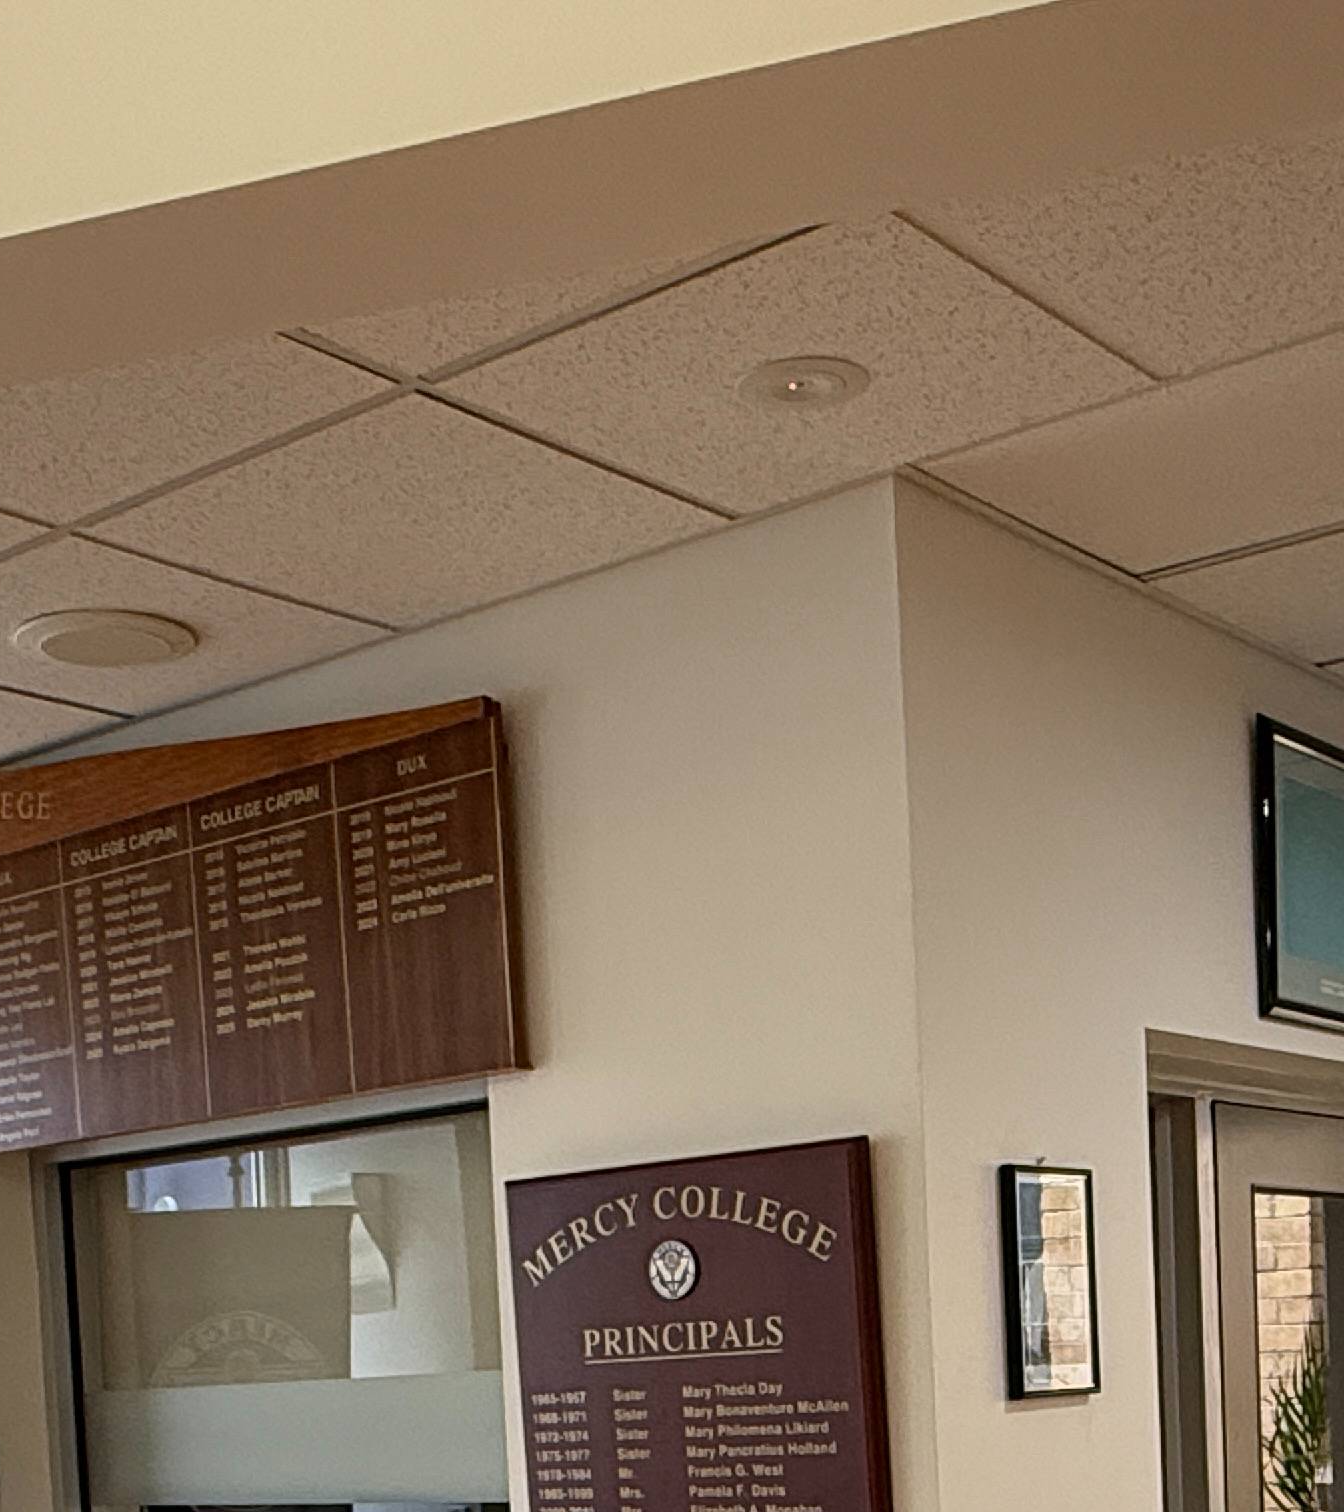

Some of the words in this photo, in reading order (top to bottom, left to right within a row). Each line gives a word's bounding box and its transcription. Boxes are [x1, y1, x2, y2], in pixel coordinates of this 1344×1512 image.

[396, 754, 428, 777] DUX
[199, 799, 263, 832] COLLEGE
[264, 783, 321, 813] CAPTAIN
[70, 837, 127, 867] COLLEGE
[128, 824, 177, 851] CAPTAIN
[522, 1193, 639, 1288] MERCY
[653, 1184, 838, 1262] COLLEGE
[583, 1315, 784, 1358] PRINCIPALS
[613, 1388, 647, 1402] Sister
[682, 1385, 712, 1400] Mary
[758, 1381, 784, 1397] Day
[614, 1408, 648, 1422] Sister
[683, 1405, 714, 1420] Mary
[616, 1427, 649, 1441] Sister
[685, 1424, 714, 1440] Mary
[616, 1446, 652, 1461] Sister
[686, 1445, 716, 1460] Mary
[787, 1440, 838, 1456] Holland
[752, 1463, 784, 1477] West
[619, 1486, 646, 1499] Mrs.
[751, 1483, 786, 1497] Davis
